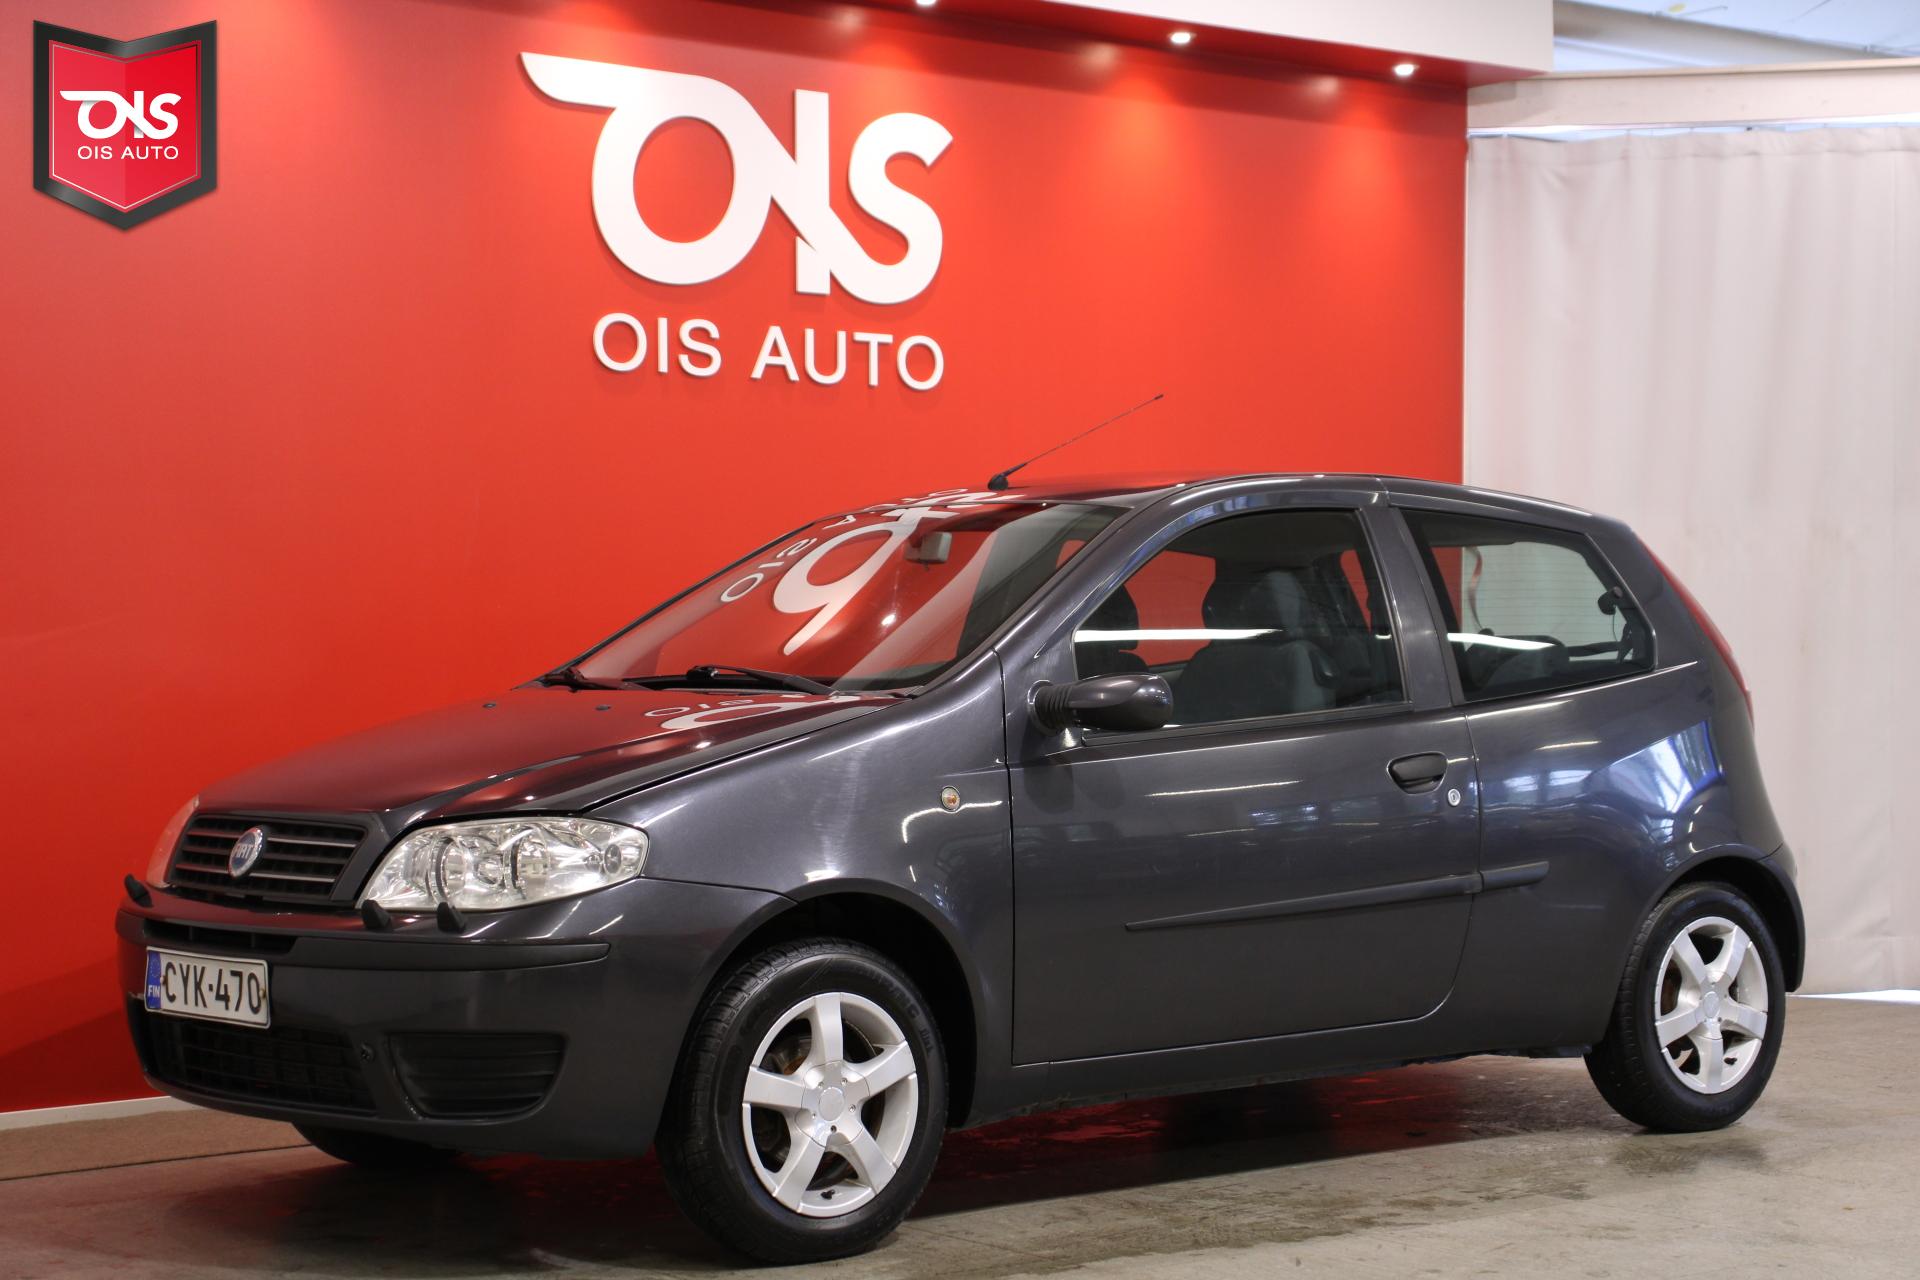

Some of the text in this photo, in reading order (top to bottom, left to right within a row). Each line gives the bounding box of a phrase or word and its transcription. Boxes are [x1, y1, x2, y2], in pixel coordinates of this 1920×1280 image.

[520, 52, 953, 305] OIS
[592, 312, 944, 391] OIS AUTO
[148, 985, 160, 997] FIN
